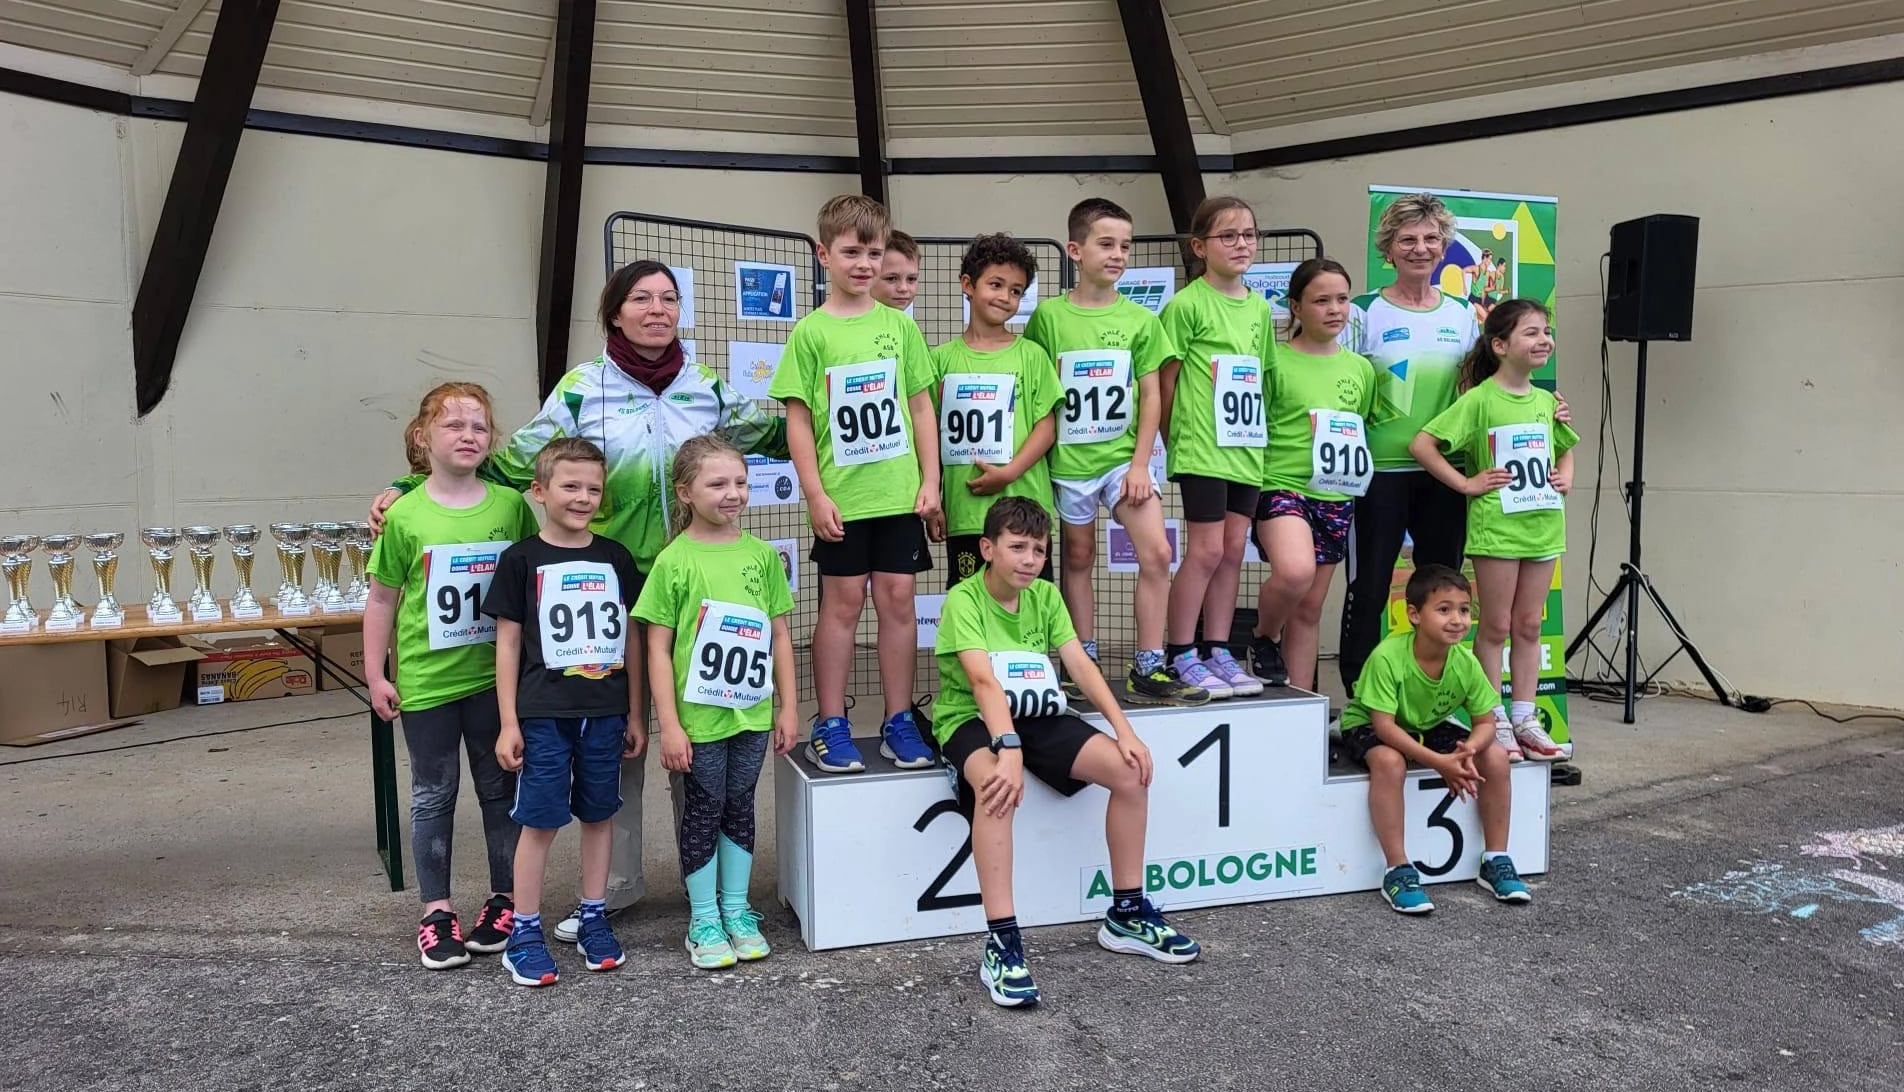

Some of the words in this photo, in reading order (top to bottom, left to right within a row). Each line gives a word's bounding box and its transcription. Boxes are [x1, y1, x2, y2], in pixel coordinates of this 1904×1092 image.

[837, 398, 901, 443] 902
[1065, 385, 1126, 423] 912
[1223, 391, 1262, 426] 907
[947, 408, 1003, 444] 901
[1067, 427, 1088, 435] Crédit
[1097, 424, 1123, 433] Mutuel
[844, 447, 869, 457] Crédit
[949, 448, 969, 456] Crédit
[977, 448, 1003, 456] Mutuel
[1319, 442, 1369, 478] 910
[437, 583, 481, 625] 91
[549, 601, 621, 643] 913
[443, 628, 468, 639] Crédit
[477, 625, 497, 634] Mutu
[556, 648, 583, 657] Crédit
[699, 642, 768, 689] 905
[201, 671, 238, 680] BANANAS
[285, 675, 307, 685] Dole
[697, 685, 723, 698] Crédit
[733, 690, 762, 702] Mutuel
[1177, 723, 1231, 828] 1
[1412, 777, 1465, 876] 3
[913, 798, 982, 912] 2
[1085, 868, 1115, 900] A
[1145, 847, 1318, 890] BOLOGNE
